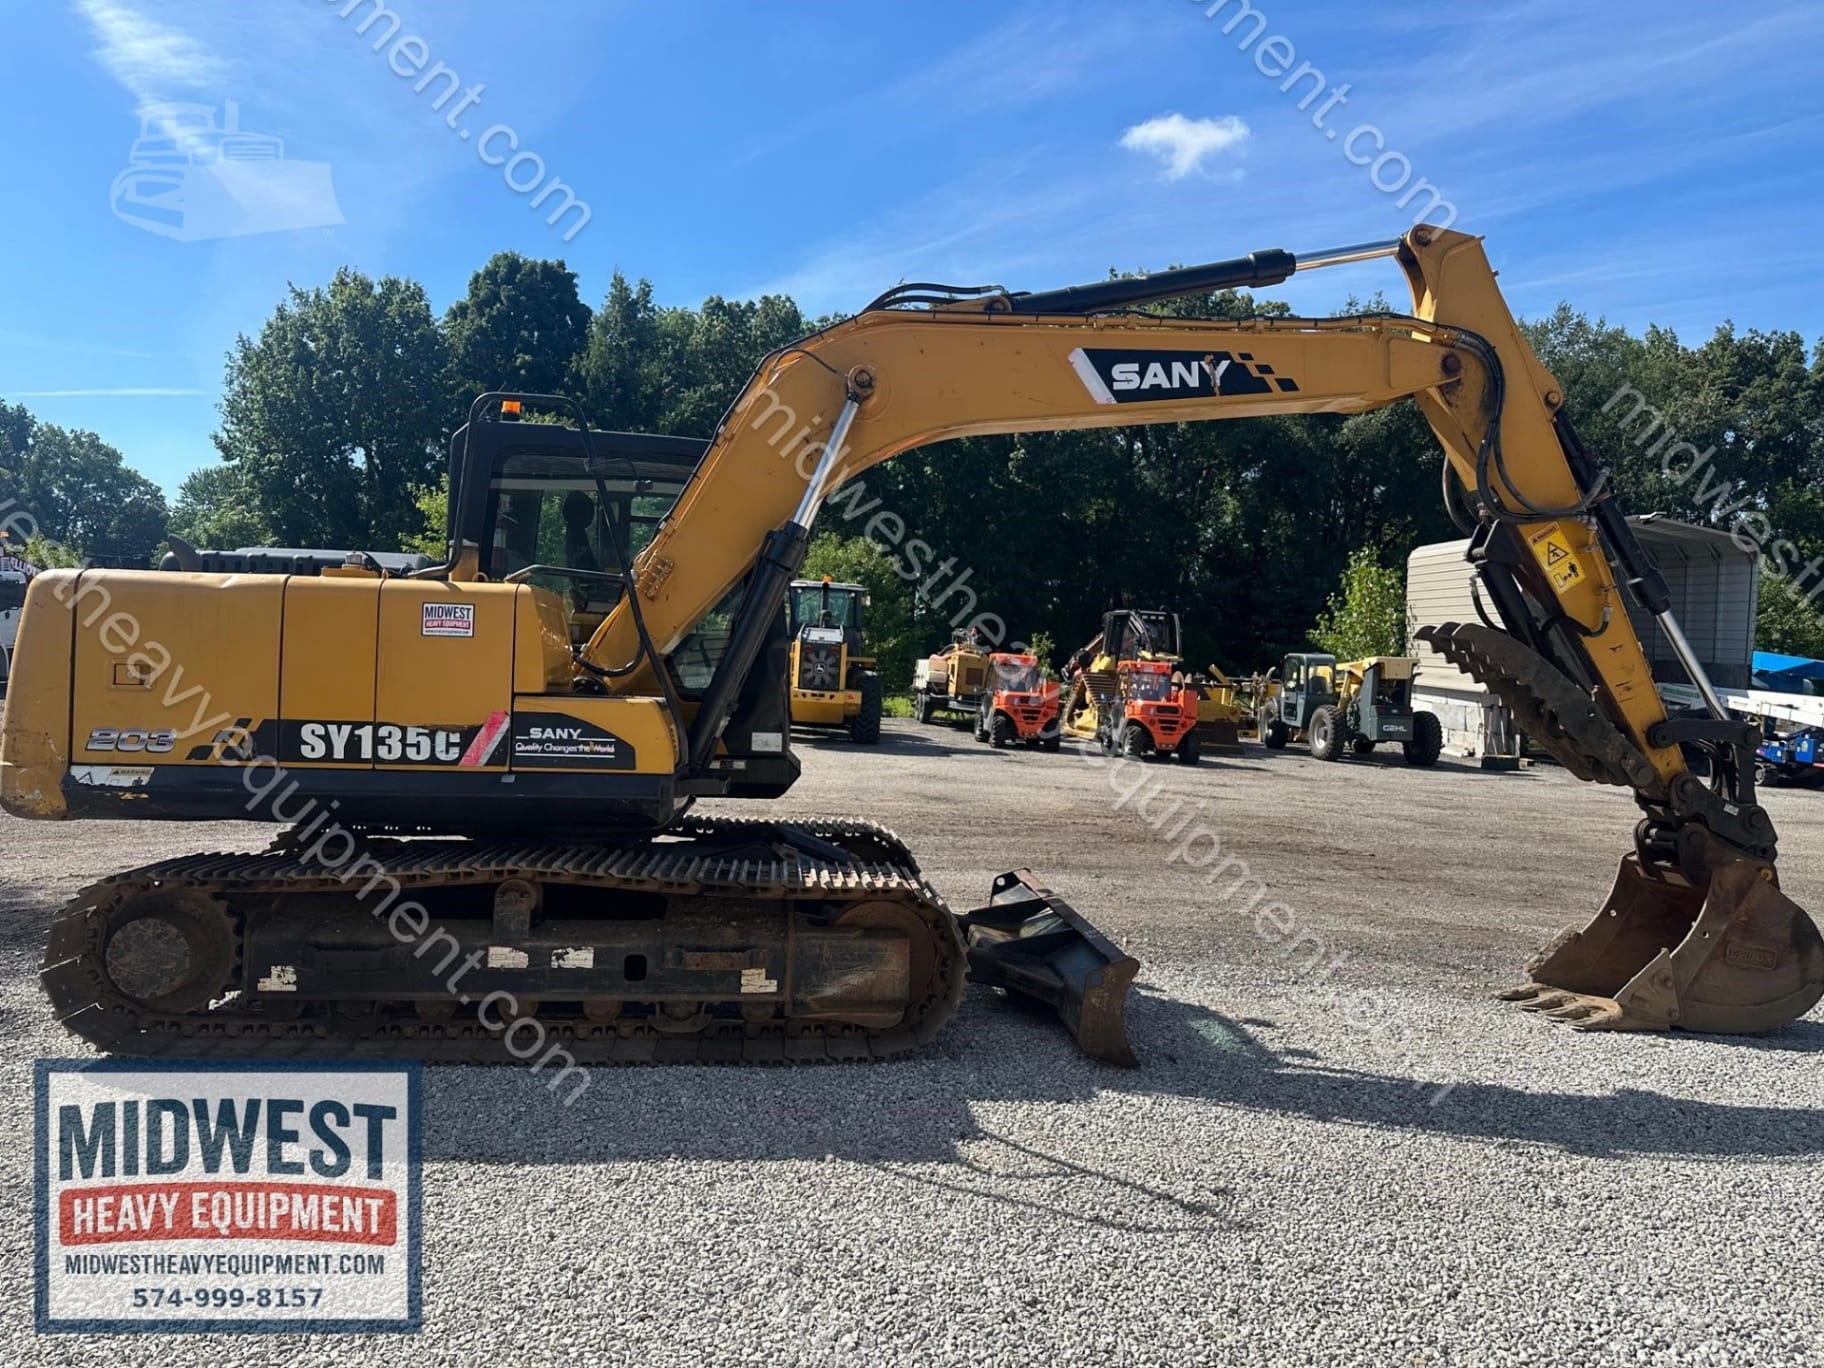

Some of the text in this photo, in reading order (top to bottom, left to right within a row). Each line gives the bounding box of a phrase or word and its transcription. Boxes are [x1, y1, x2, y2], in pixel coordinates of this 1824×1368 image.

[1111, 360, 1231, 390] SANY
[425, 606, 472, 619] MIDWEST
[529, 727, 582, 739] SANY
[1382, 724, 1407, 732] GEHL
[85, 727, 177, 752] 203
[300, 722, 461, 761] SY135C
[515, 742, 615, 753] Quality Changes the World
